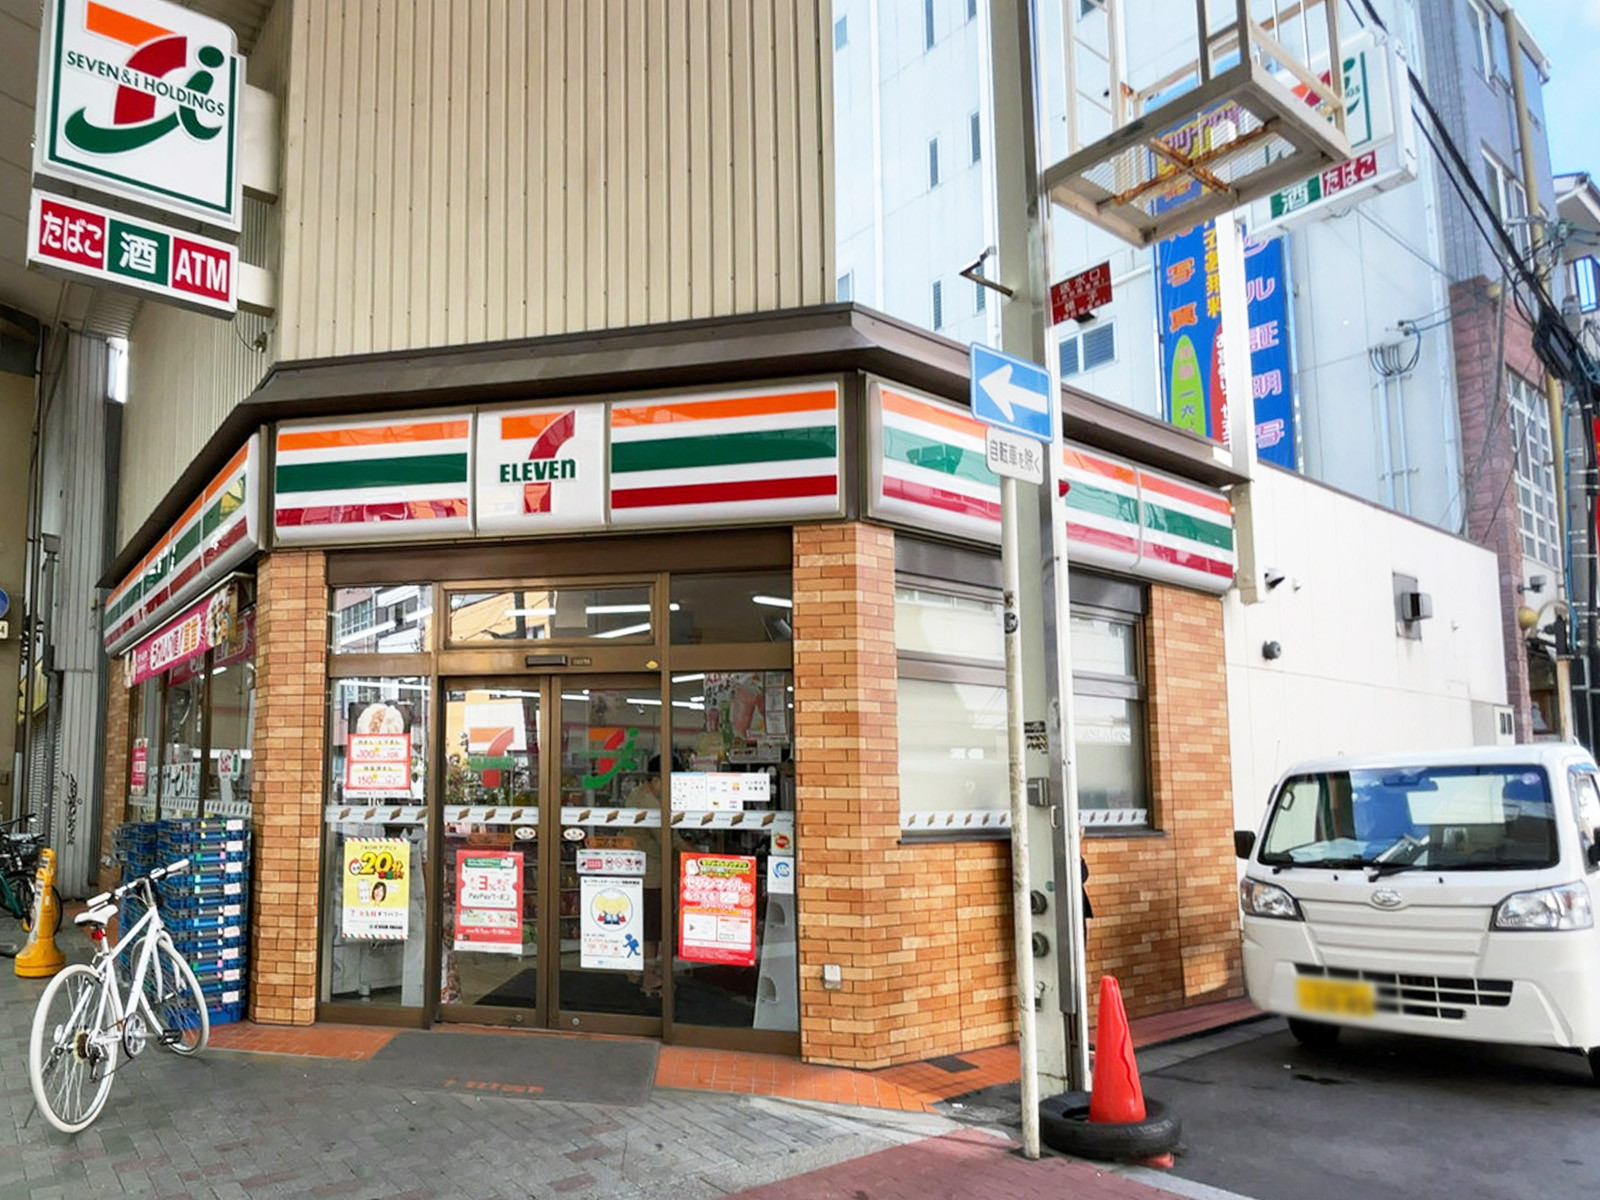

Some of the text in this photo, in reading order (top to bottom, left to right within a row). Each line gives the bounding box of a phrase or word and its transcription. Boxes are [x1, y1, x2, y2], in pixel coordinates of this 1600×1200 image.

[144, 77, 226, 117] HOLDINGS
[1281, 183, 1310, 215] 酒
[41, 210, 228, 294] たばこ 酒 ATM
[989, 438, 1041, 474] 自転車を除く
